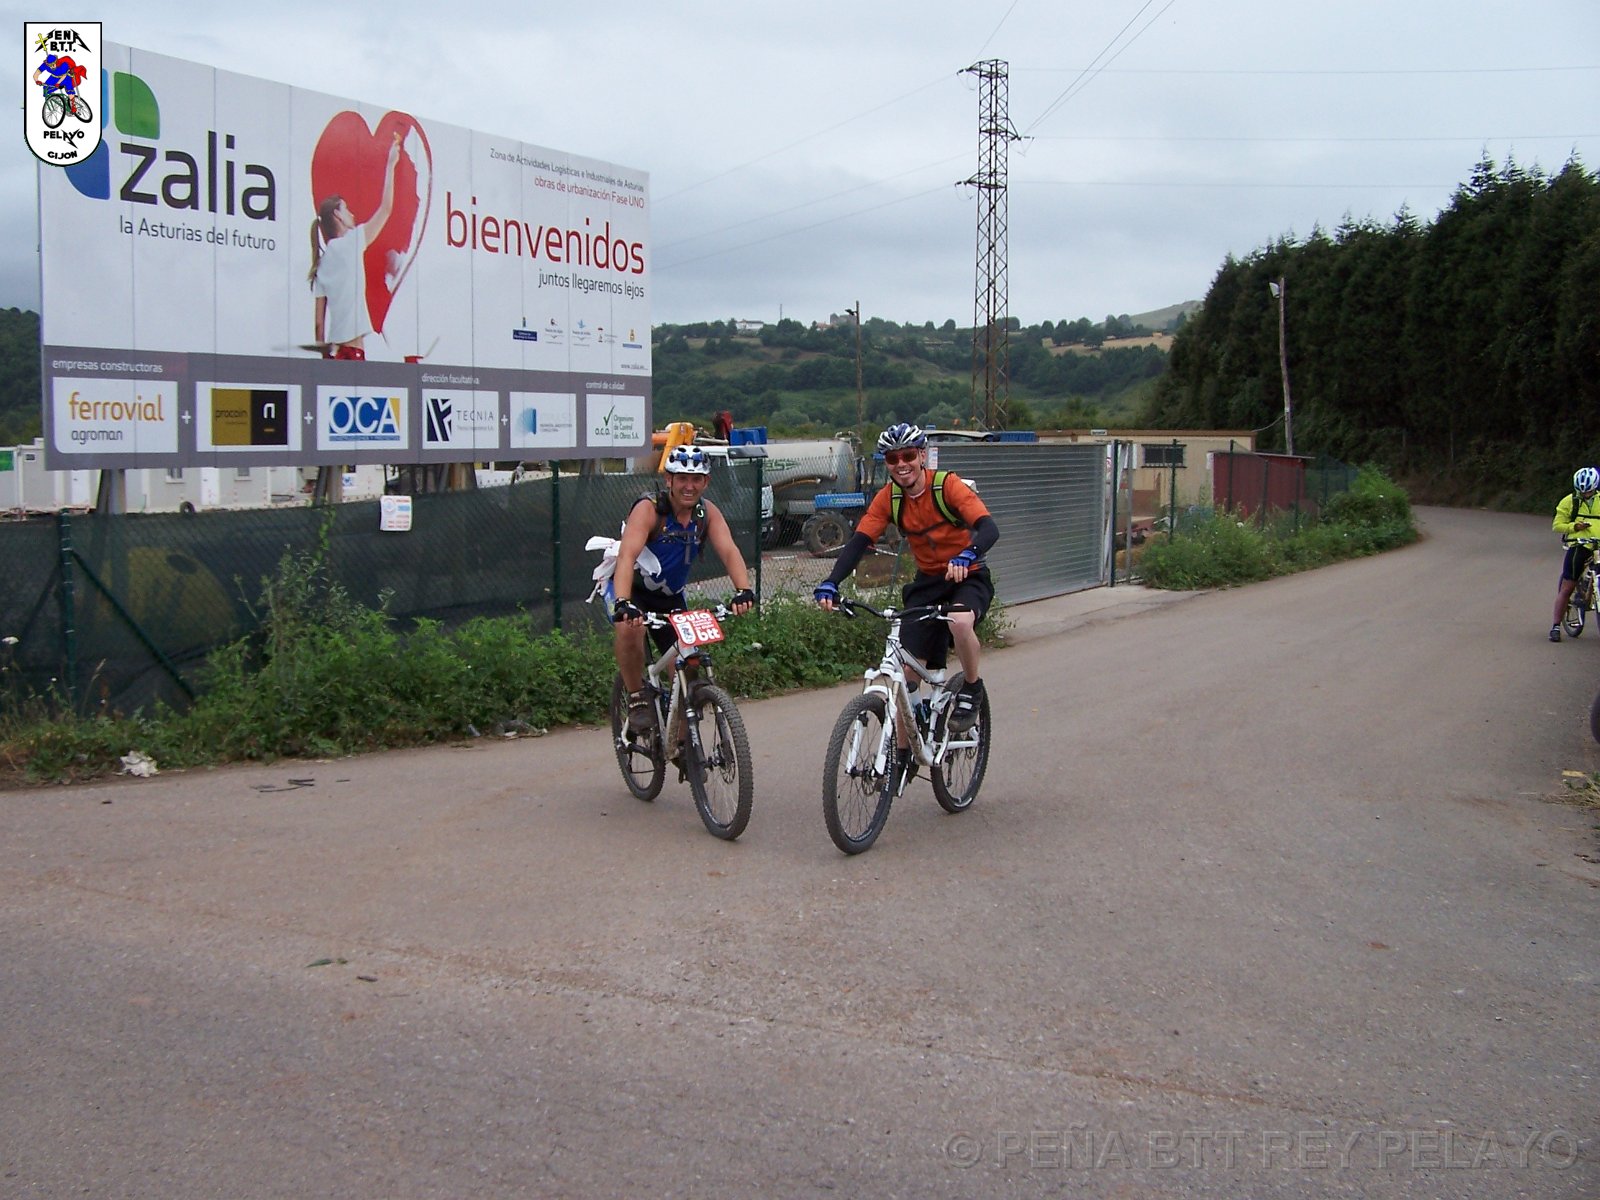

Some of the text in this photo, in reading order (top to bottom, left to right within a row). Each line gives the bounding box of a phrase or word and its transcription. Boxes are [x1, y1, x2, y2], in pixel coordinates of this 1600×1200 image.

[119, 130, 276, 221] zalia
[490, 147, 507, 161] Zona
[507, 153, 515, 163] de
[516, 154, 550, 171] Actividades
[624, 179, 645, 193] Asturias
[534, 176, 645, 209] obras de urbanización Fase UNO
[119, 215, 276, 251] la Asturias del futuro
[446, 191, 645, 275] bienvenidos
[538, 268, 645, 300] juntos llegaremos lejos
[52, 359, 164, 374] empresas constructoras
[421, 372, 449, 383] dirección
[69, 391, 165, 422] ferrovial
[329, 397, 400, 434] OCA
[456, 409, 495, 422] TECNIA
[71, 430, 123, 445] agroman
[696, 628, 721, 642] btt
